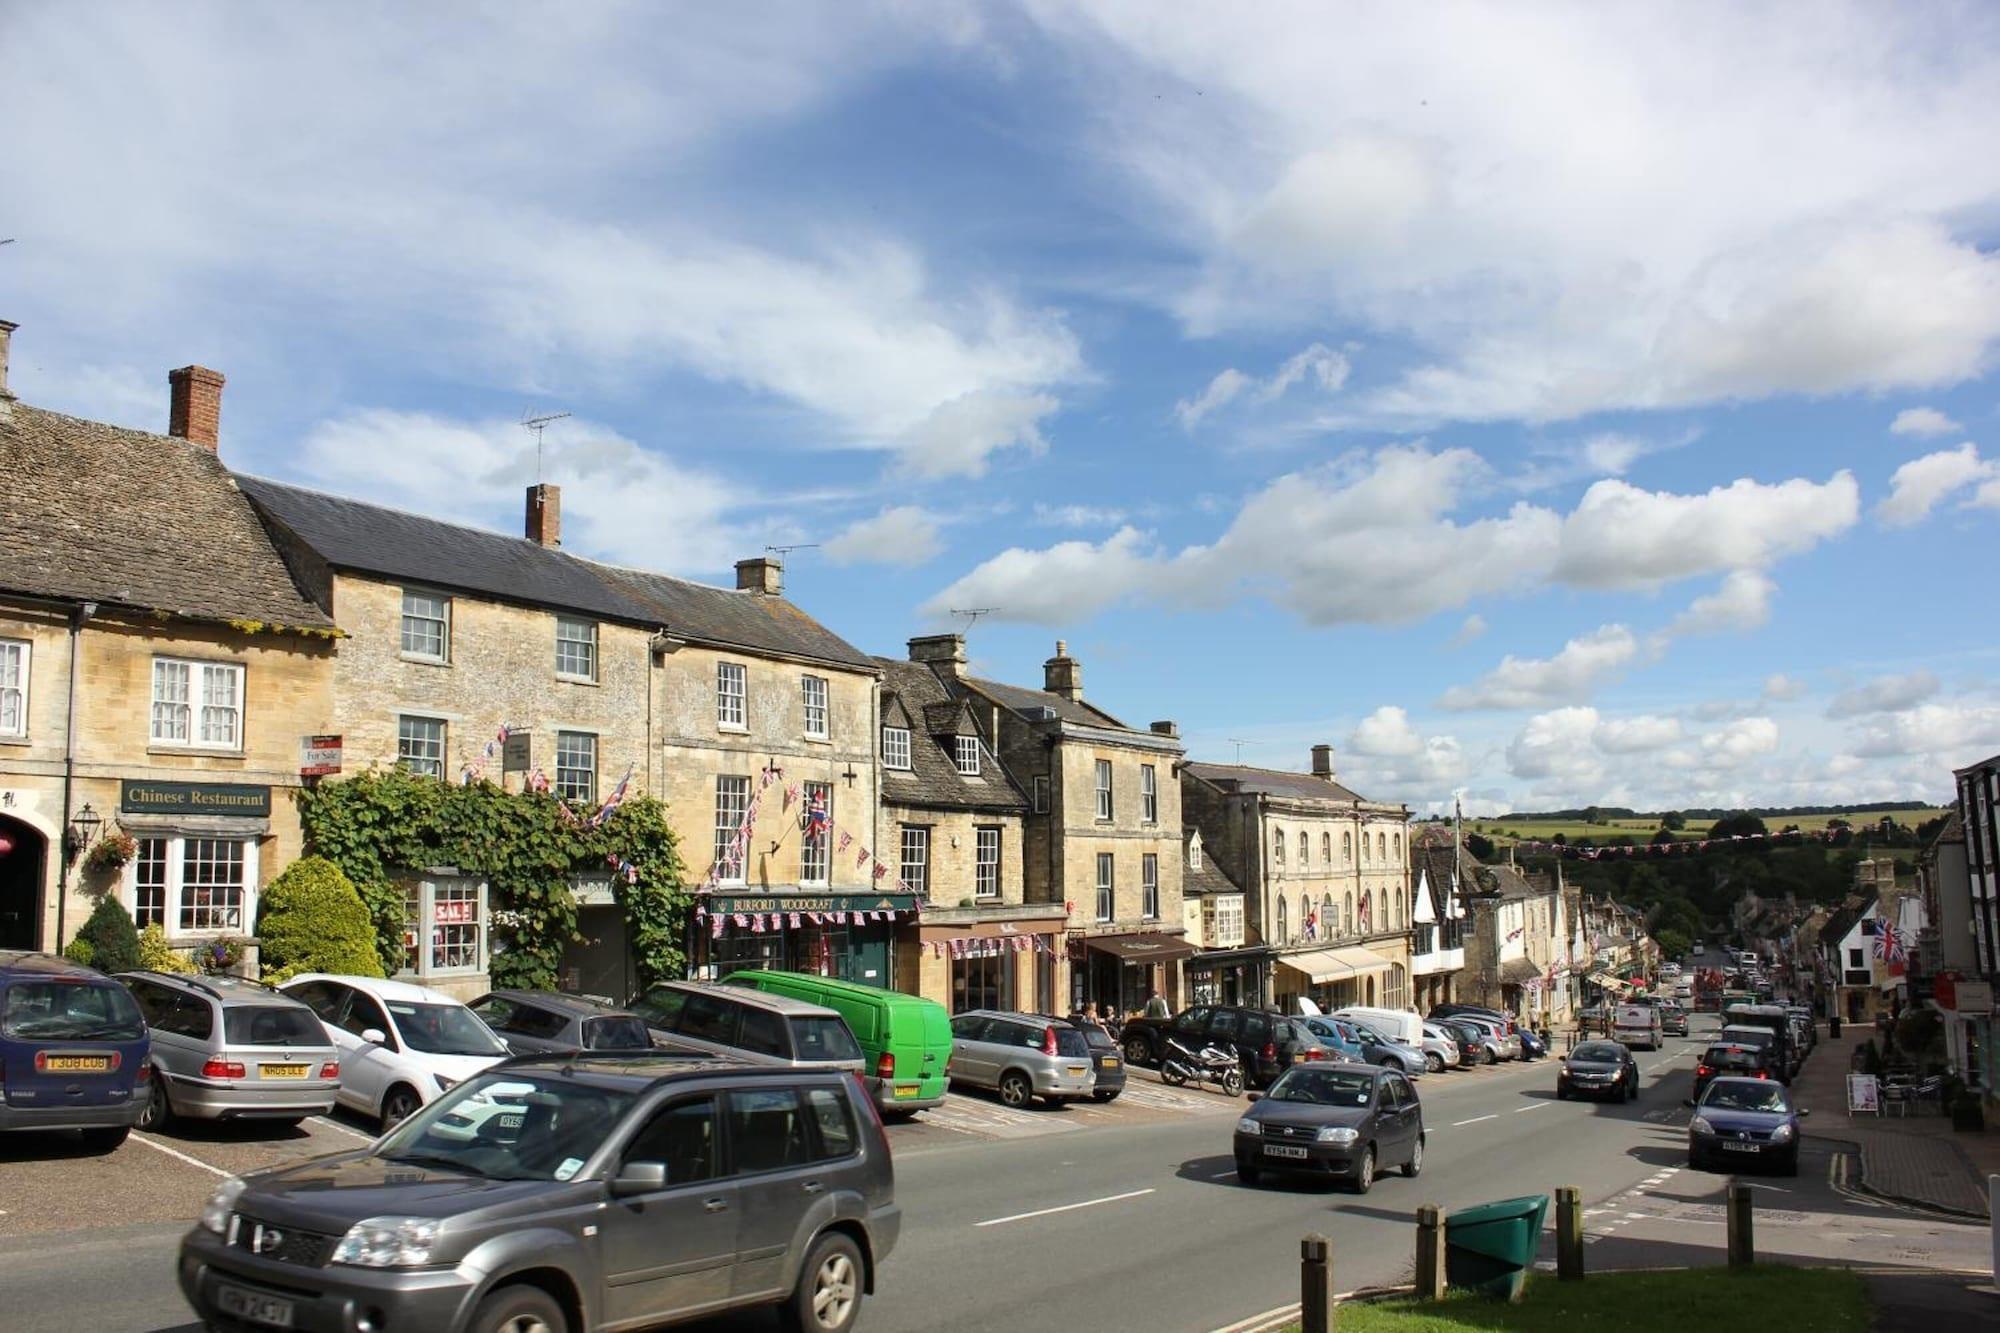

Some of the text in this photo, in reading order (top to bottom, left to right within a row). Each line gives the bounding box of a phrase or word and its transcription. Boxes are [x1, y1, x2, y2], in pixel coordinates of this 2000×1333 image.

[307, 749, 336, 761] For Sale
[128, 788, 264, 806] Chinese Restaurant
[436, 904, 470, 919] SALE
[733, 898, 834, 911] BURFORD WOODCRAFT
